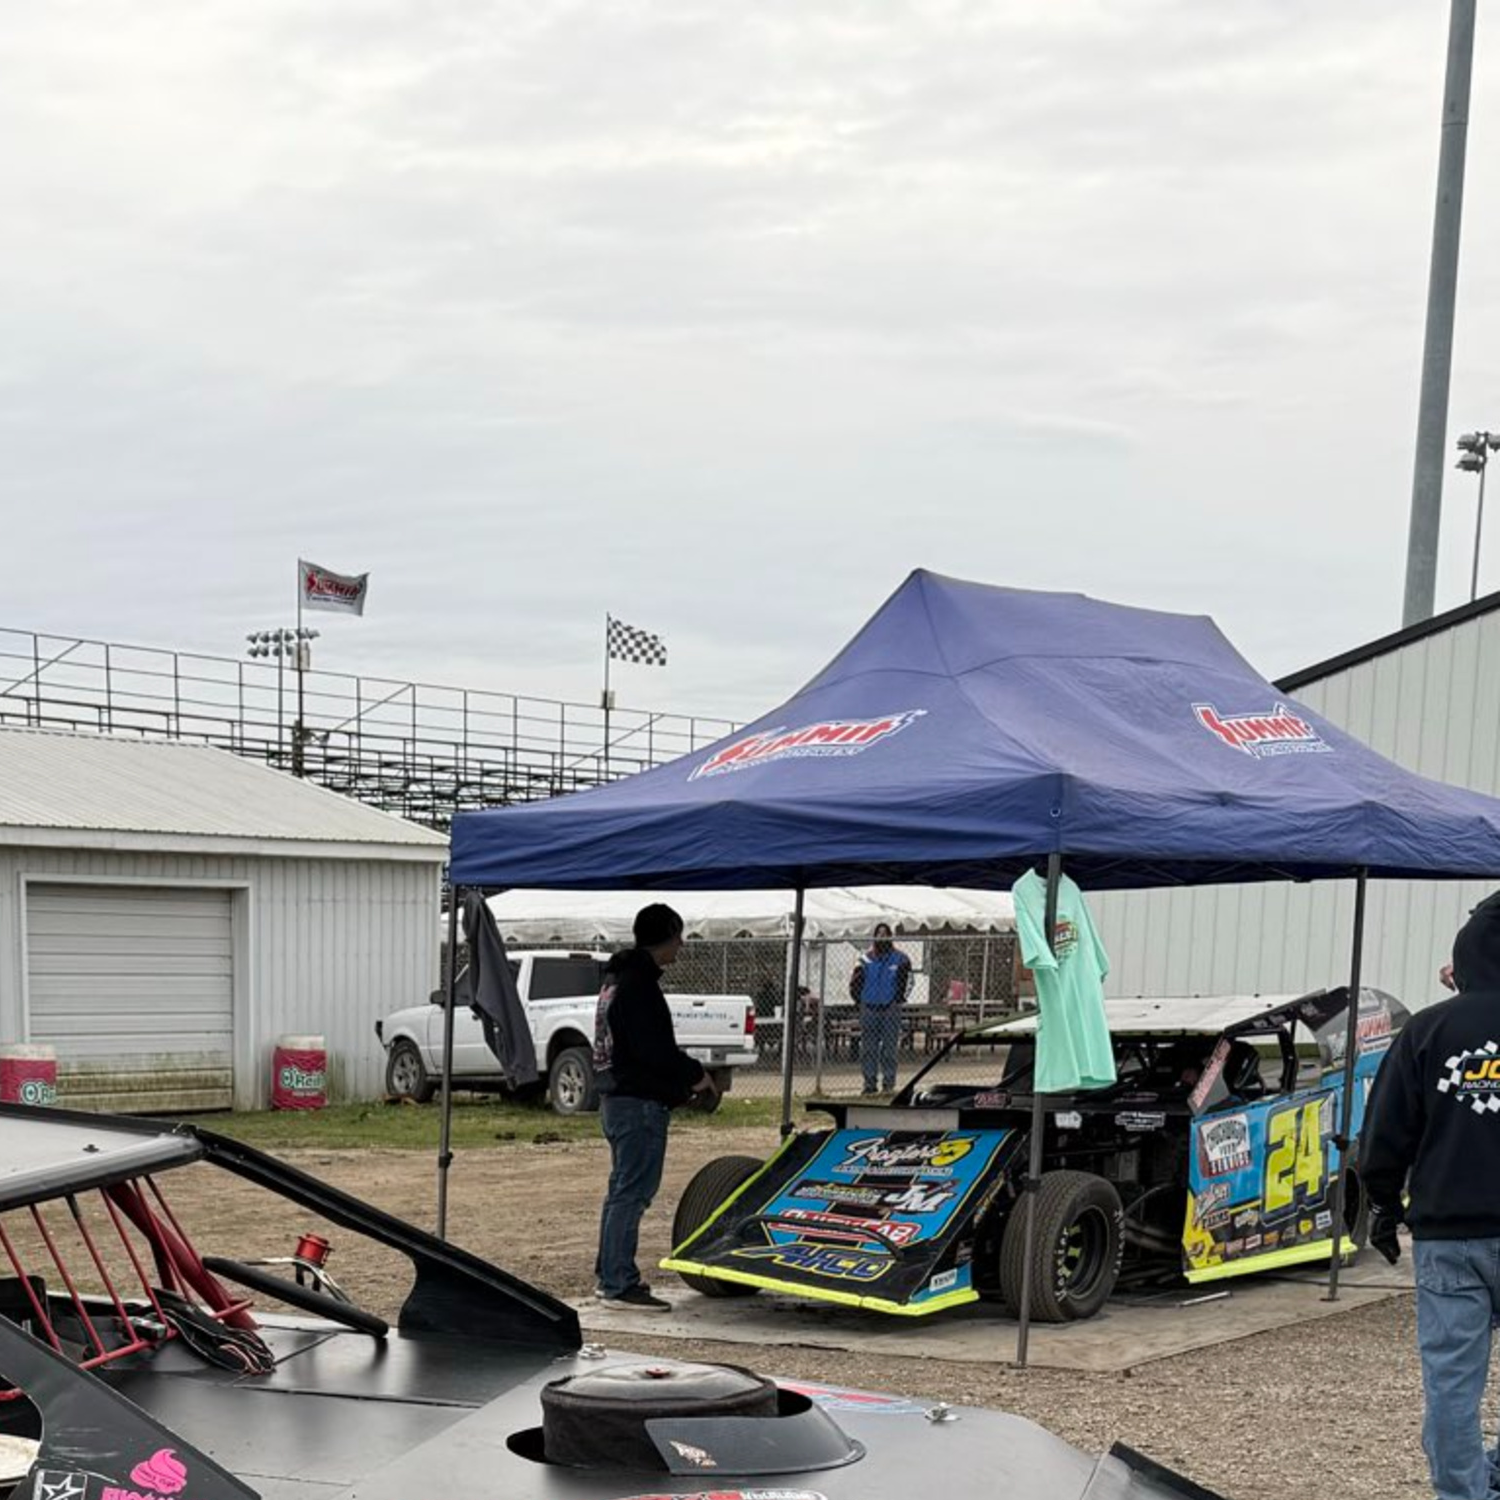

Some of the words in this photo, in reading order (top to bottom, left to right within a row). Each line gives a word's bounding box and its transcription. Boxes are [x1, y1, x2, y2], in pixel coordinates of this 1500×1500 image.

[694, 712, 912, 778] SUMMIT
[1193, 702, 1316, 748] SUMMIT
[1266, 1098, 1325, 1214] 24
